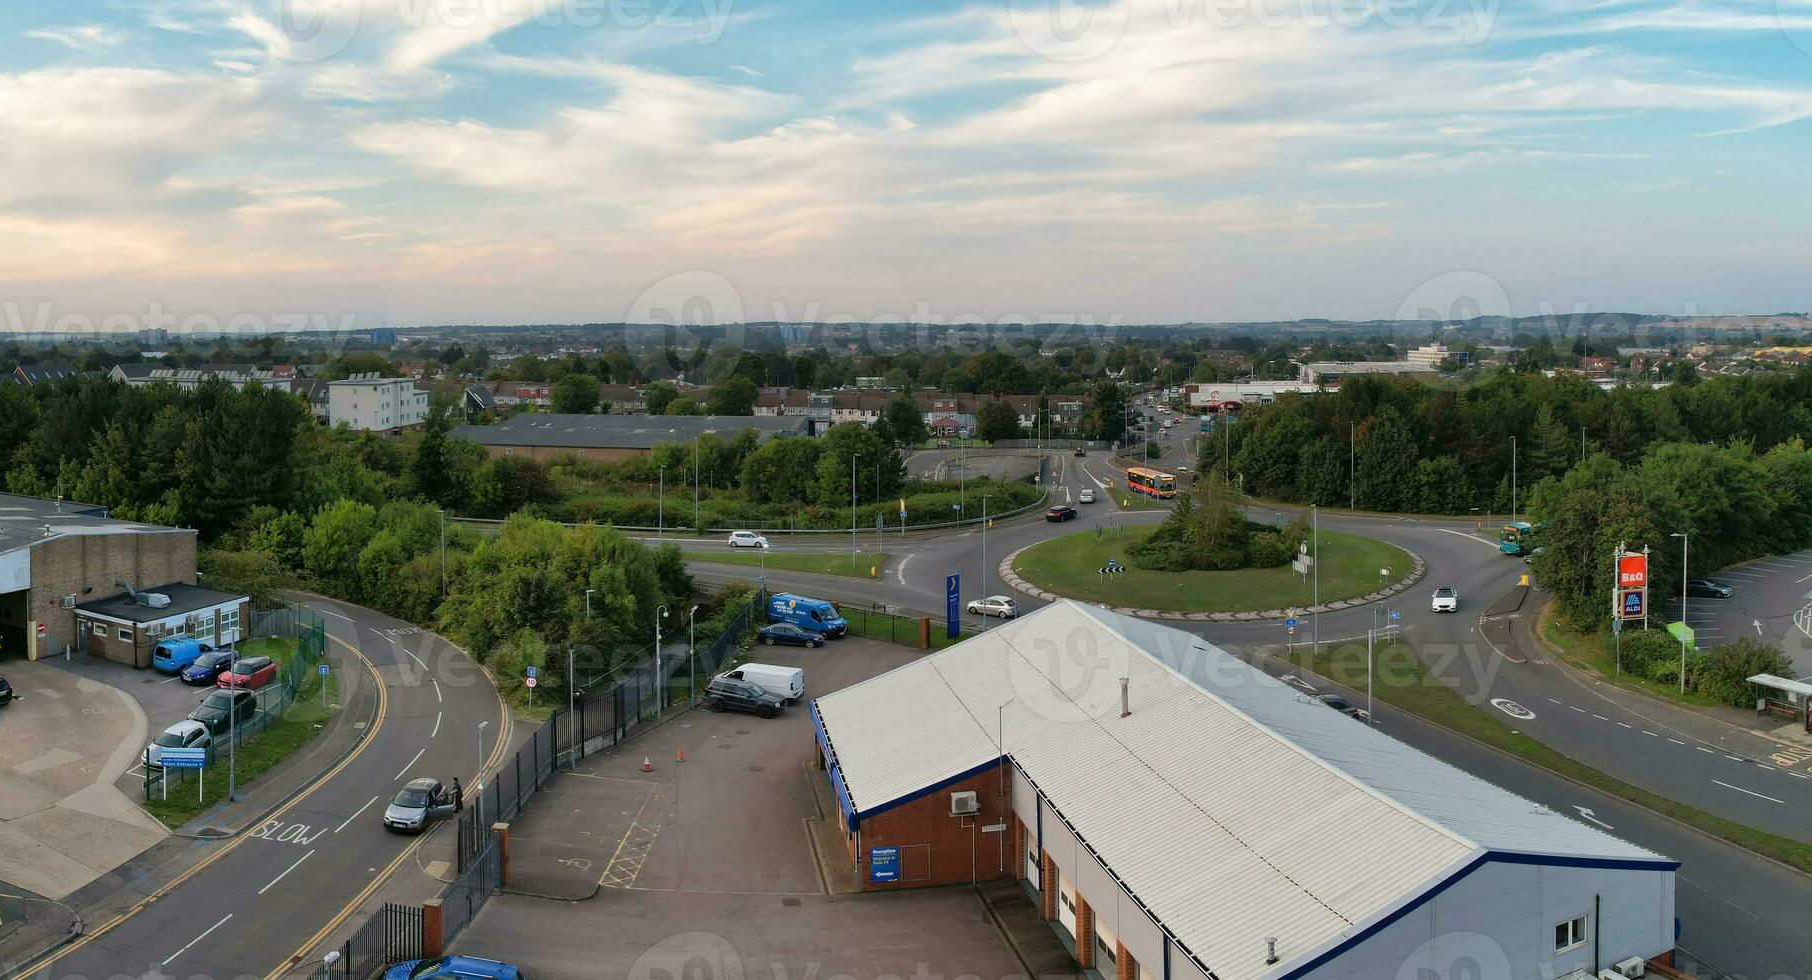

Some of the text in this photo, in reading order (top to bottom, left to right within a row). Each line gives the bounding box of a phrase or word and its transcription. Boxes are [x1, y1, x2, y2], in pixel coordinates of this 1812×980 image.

[1621, 571, 1643, 583] B&Q
[1625, 605, 1641, 613] ALDI
[250, 820, 328, 845] SLOW
